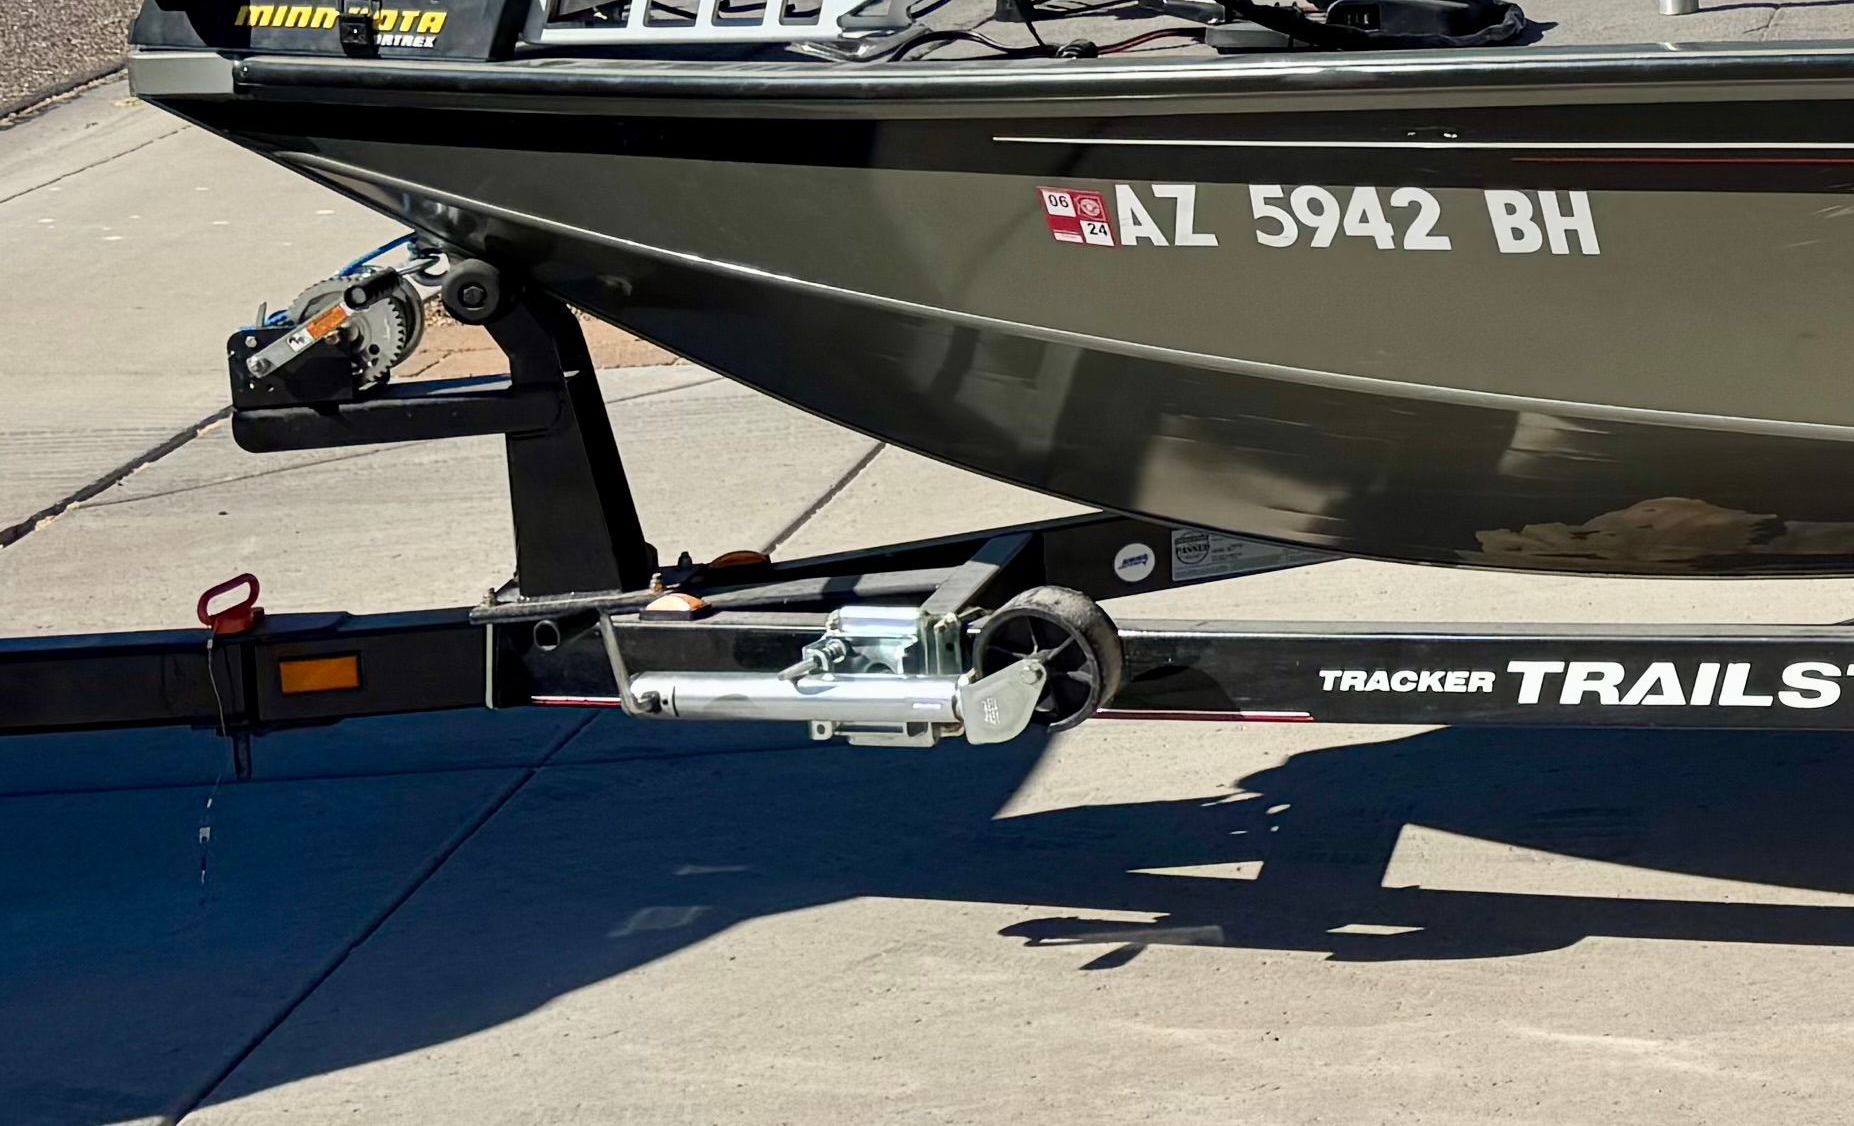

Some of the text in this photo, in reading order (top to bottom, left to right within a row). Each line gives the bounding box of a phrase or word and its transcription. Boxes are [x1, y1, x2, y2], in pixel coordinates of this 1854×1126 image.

[235, 4, 340, 29] MINN
[375, 34, 440, 48] RTREX
[1047, 194, 1069, 208] 06
[1087, 222, 1108, 236] 24
[1114, 184, 1601, 255] AZ 5942 BH
[1319, 669, 1495, 694] TRACKER
